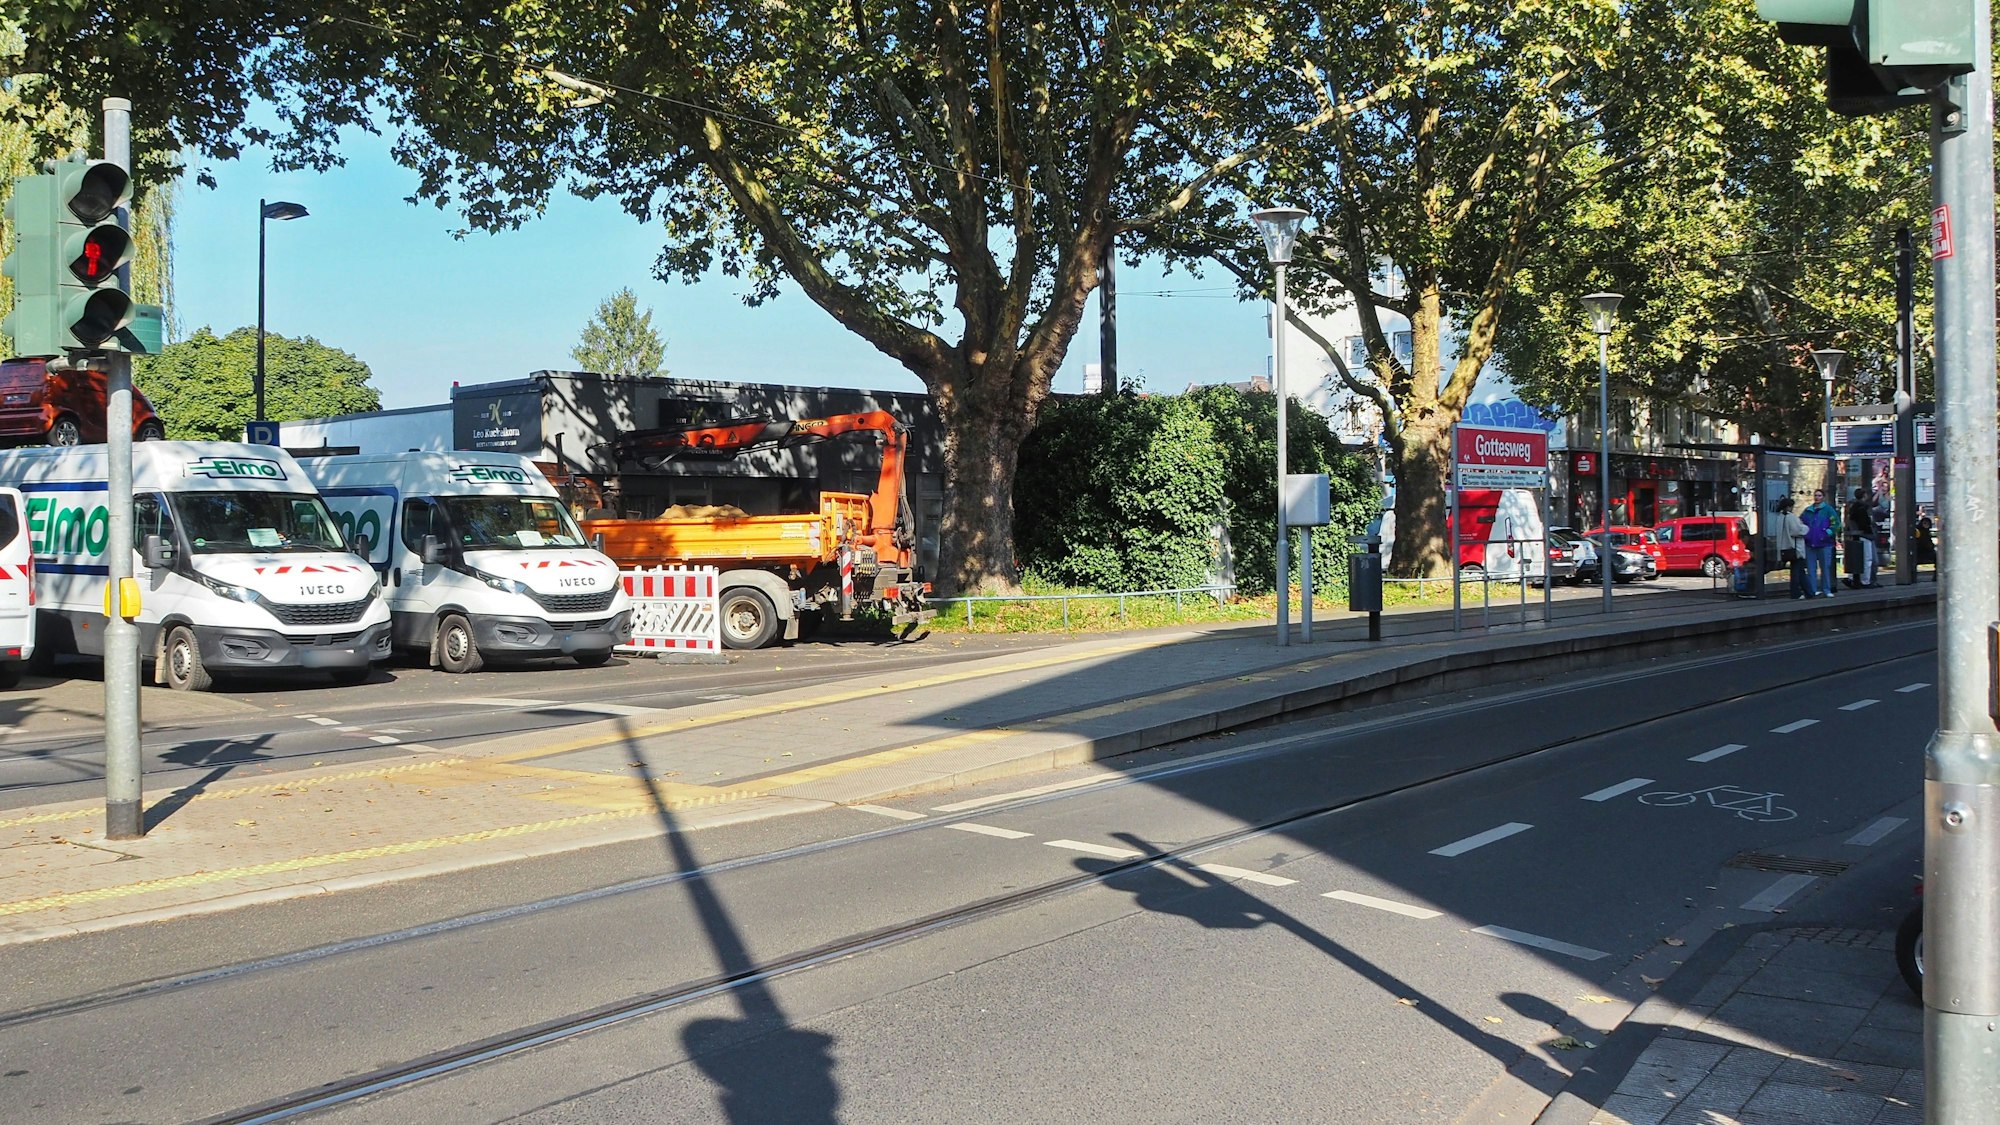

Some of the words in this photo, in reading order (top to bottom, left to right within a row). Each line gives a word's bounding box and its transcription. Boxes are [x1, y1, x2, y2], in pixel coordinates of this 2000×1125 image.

[488, 399, 503, 426] K
[473, 430, 484, 438] Leo
[1475, 434, 1531, 462] Gottesweg
[213, 460, 276, 476] Elmo
[471, 468, 524, 481] Elmo
[26, 498, 109, 556] Elmo
[331, 509, 380, 551] mo
[300, 585, 344, 595] IVECO
[560, 578, 596, 587] IVECO
